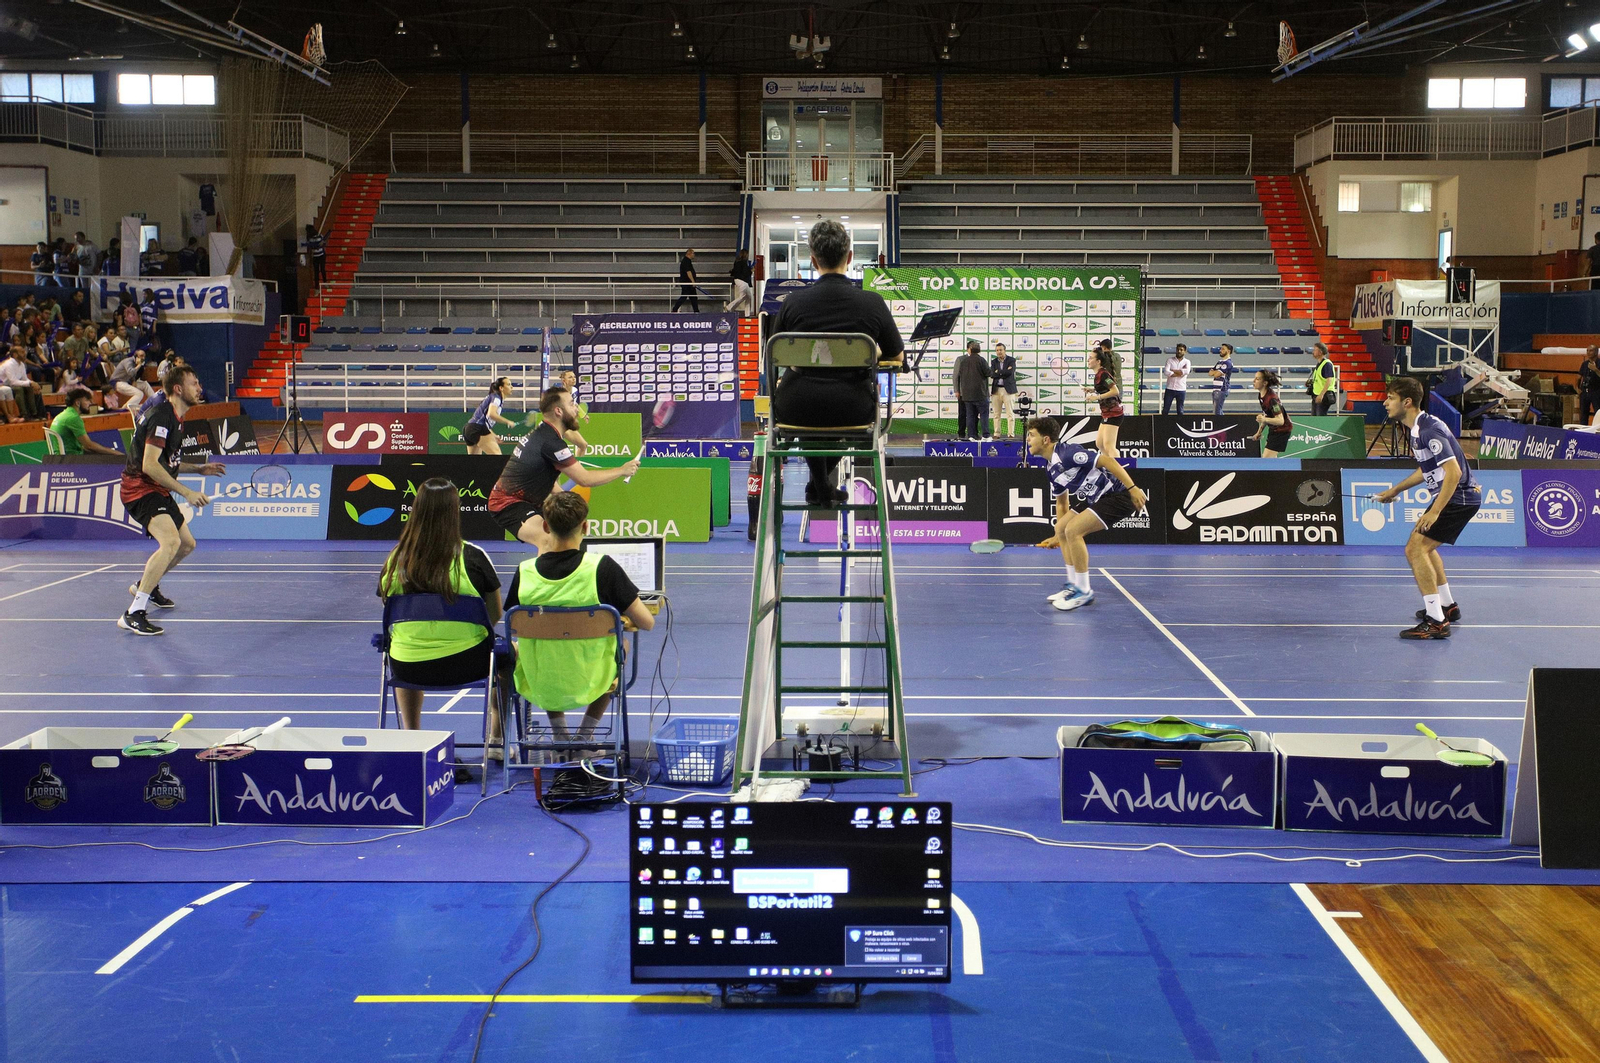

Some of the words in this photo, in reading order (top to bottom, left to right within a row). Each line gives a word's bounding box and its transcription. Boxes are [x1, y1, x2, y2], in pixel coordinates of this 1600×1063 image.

[919, 277, 954, 290] TOP
[960, 277, 979, 290] 10
[984, 277, 1084, 290] IBERDROLA
[1401, 300, 1497, 318] Información
[1168, 437, 1206, 449] Clínica
[1208, 438, 1246, 449] Dental
[1496, 437, 1521, 459] YONEX
[886, 477, 966, 503] WiHu
[1287, 512, 1336, 522] ESPAÑA
[1200, 526, 1337, 542] BADMINTON
[27, 787, 66, 800] LAORDEN
[146, 787, 184, 800] LAORDEN
[235, 772, 414, 816] Andalucía
[1080, 770, 1263, 817] Andalucía
[1304, 779, 1492, 825] Andalucía
